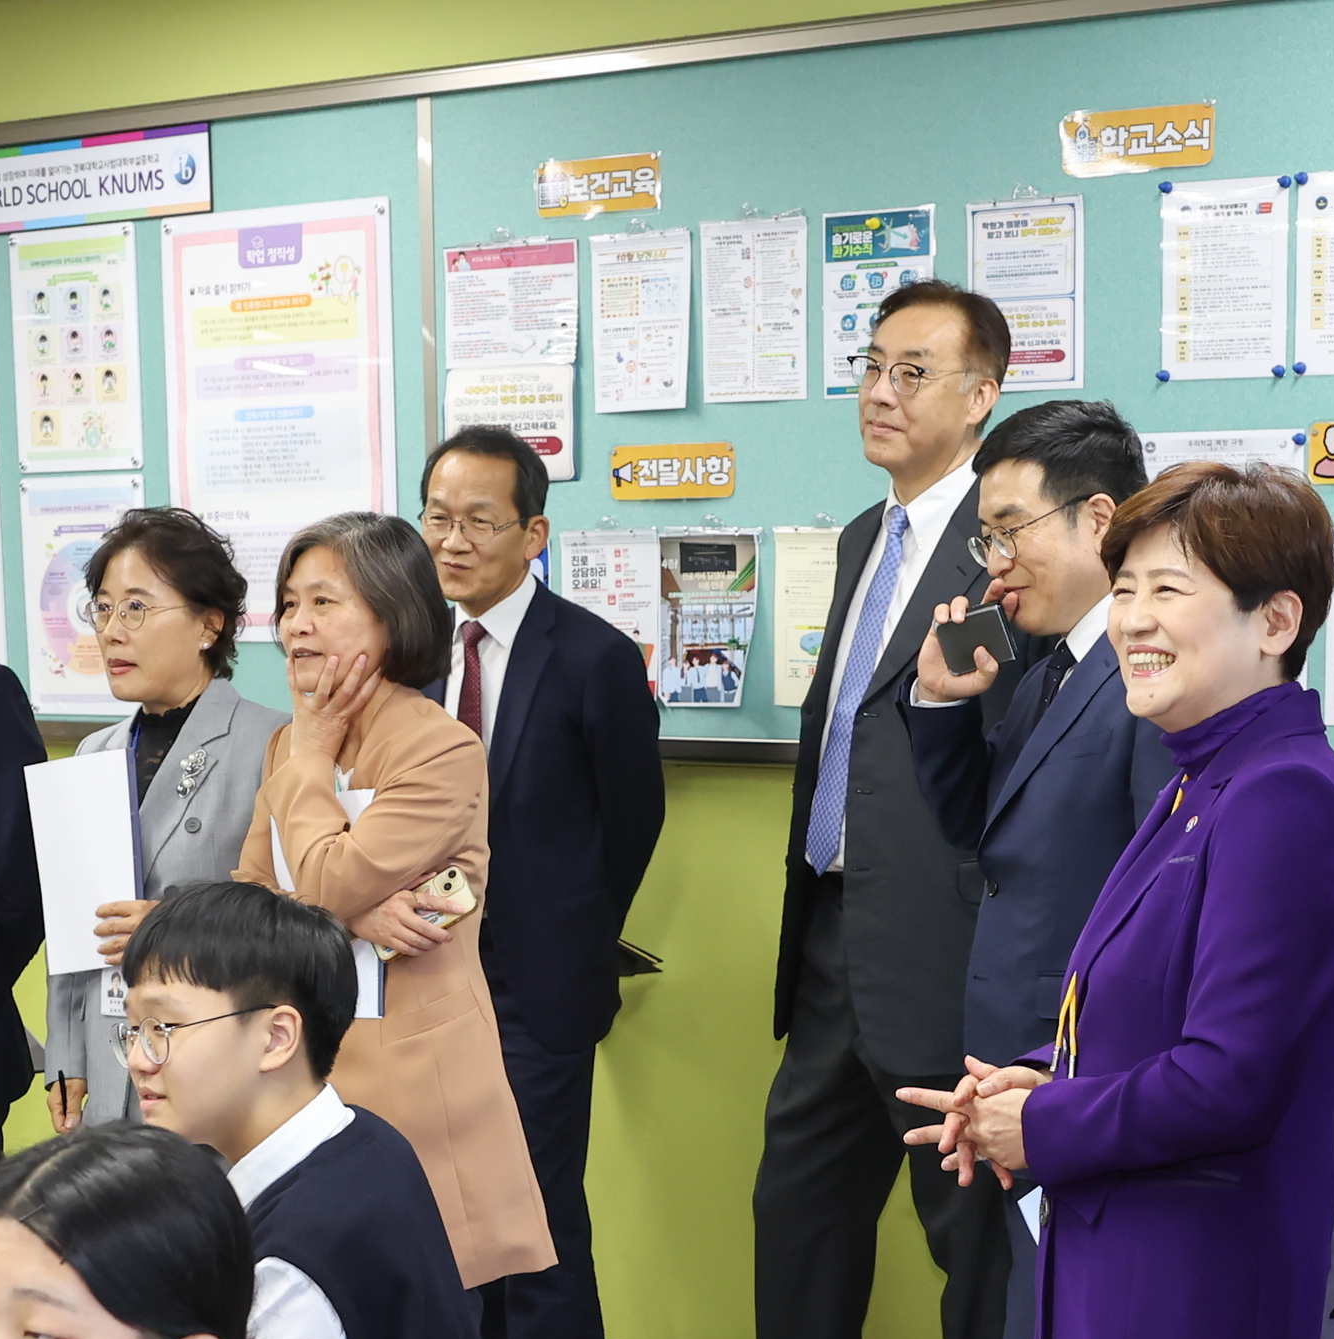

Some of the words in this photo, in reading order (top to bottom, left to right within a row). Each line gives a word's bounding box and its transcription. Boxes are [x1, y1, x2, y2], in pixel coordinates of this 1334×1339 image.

[1099, 118, 1211, 159] 학교소식
[26, 177, 92, 205] SCHOOL
[99, 169, 164, 197] KNUMS
[567, 167, 657, 202] 보건교육
[832, 231, 874, 246] 슬기로운
[246, 248, 265, 265] 학업
[267, 245, 296, 262] 정직성
[832, 244, 874, 259] 환기수칙
[514, 421, 557, 431] 신고하세요
[636, 455, 734, 488] 전달사항
[572, 556, 589, 566] 진로
[572, 567, 607, 578] 상담하러
[572, 579, 601, 590] 오세요!
